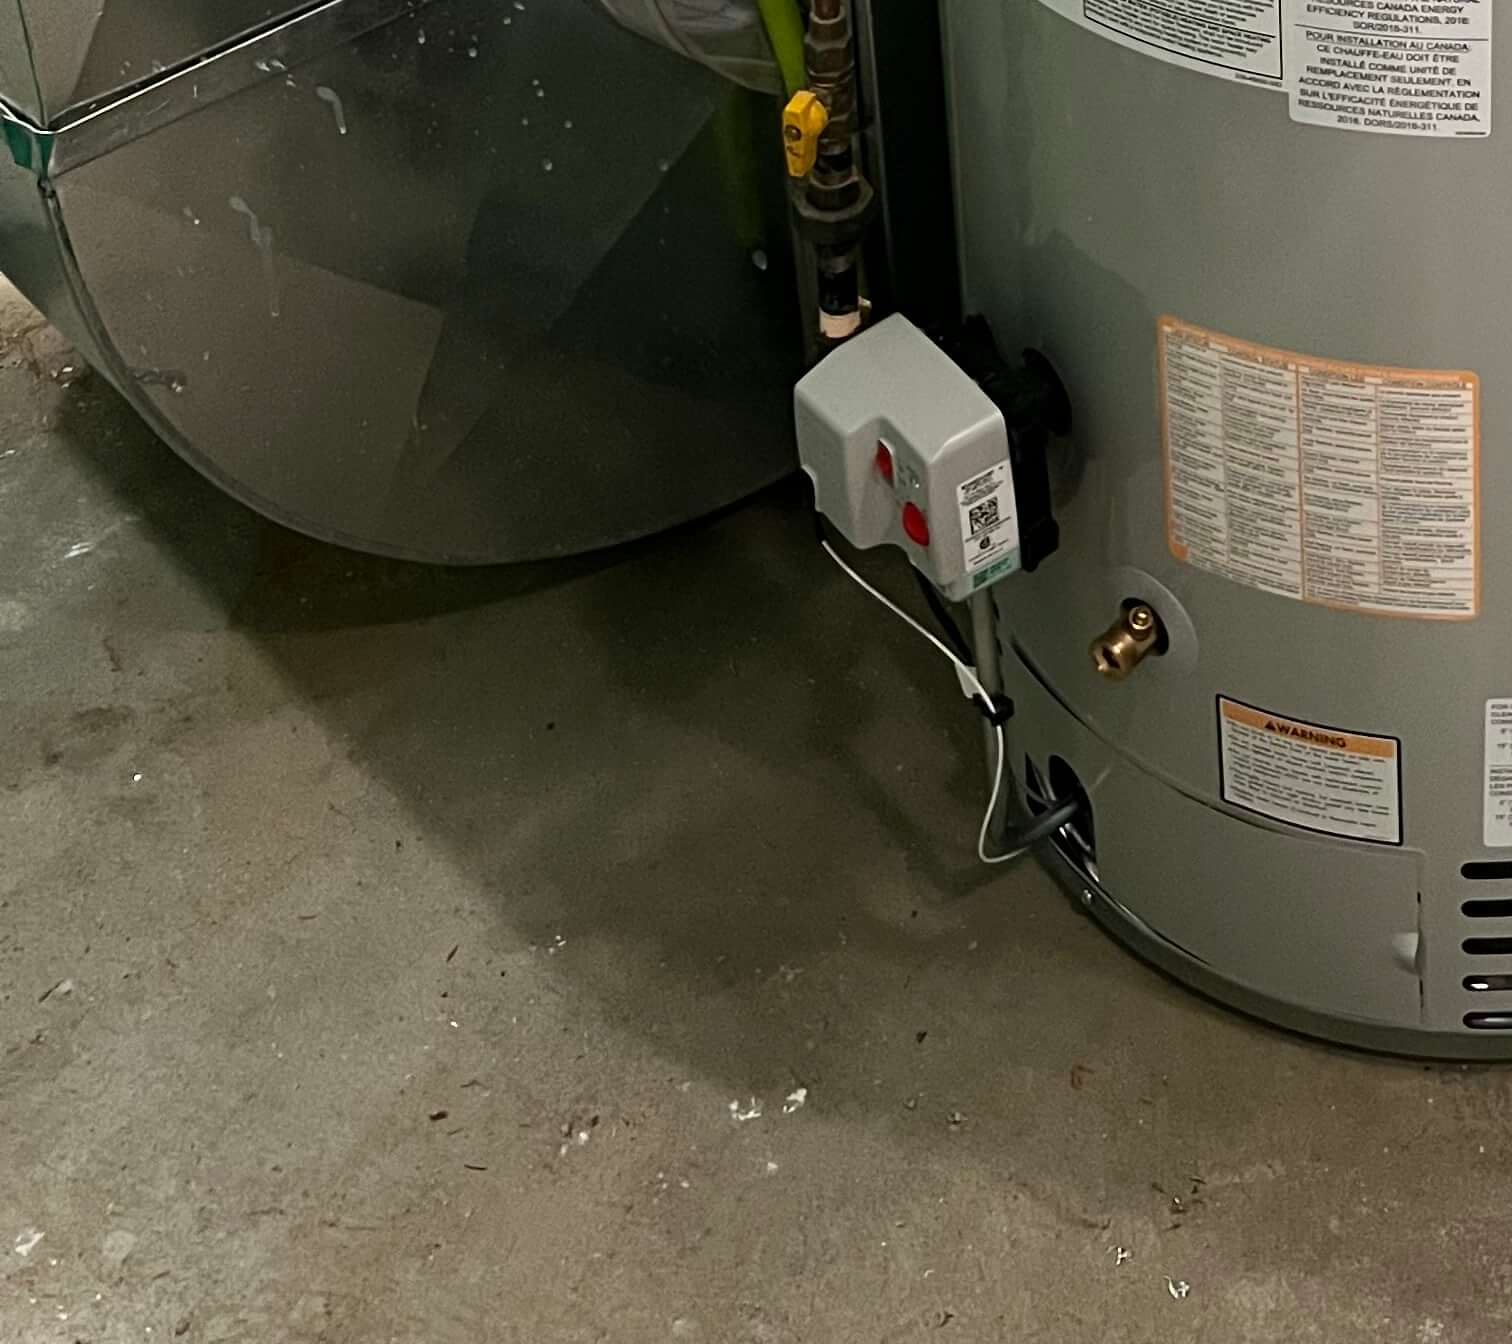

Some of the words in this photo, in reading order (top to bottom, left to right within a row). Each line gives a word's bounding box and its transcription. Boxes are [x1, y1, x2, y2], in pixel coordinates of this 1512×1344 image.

[1307, 4, 1364, 18] EFFICIENCY
[1377, 1, 1418, 12] CANADA
[1421, 4, 1463, 13] ENERGY
[1306, 31, 1333, 42] POUR
[1337, 34, 1407, 48] INSTALLATION
[1410, 41, 1423, 49] AU
[1317, 44, 1330, 53] CE
[1406, 53, 1430, 62] DOIT
[1307, 65, 1387, 82] REMPLACEMENT
[1457, 78, 1471, 86] EN
[1369, 62, 1406, 73] COMME
[1442, 67, 1456, 75] DE
[1299, 76, 1340, 89] ACCORD
[1343, 82, 1369, 93] AVEC
[1372, 85, 1384, 94] LA
[1300, 88, 1320, 99] SUR
[1465, 103, 1478, 111] DE
[1298, 98, 1365, 115] RESSOURCES
[1368, 108, 1433, 120] NATURELLES
[1275, 722, 1347, 749] WARNING
